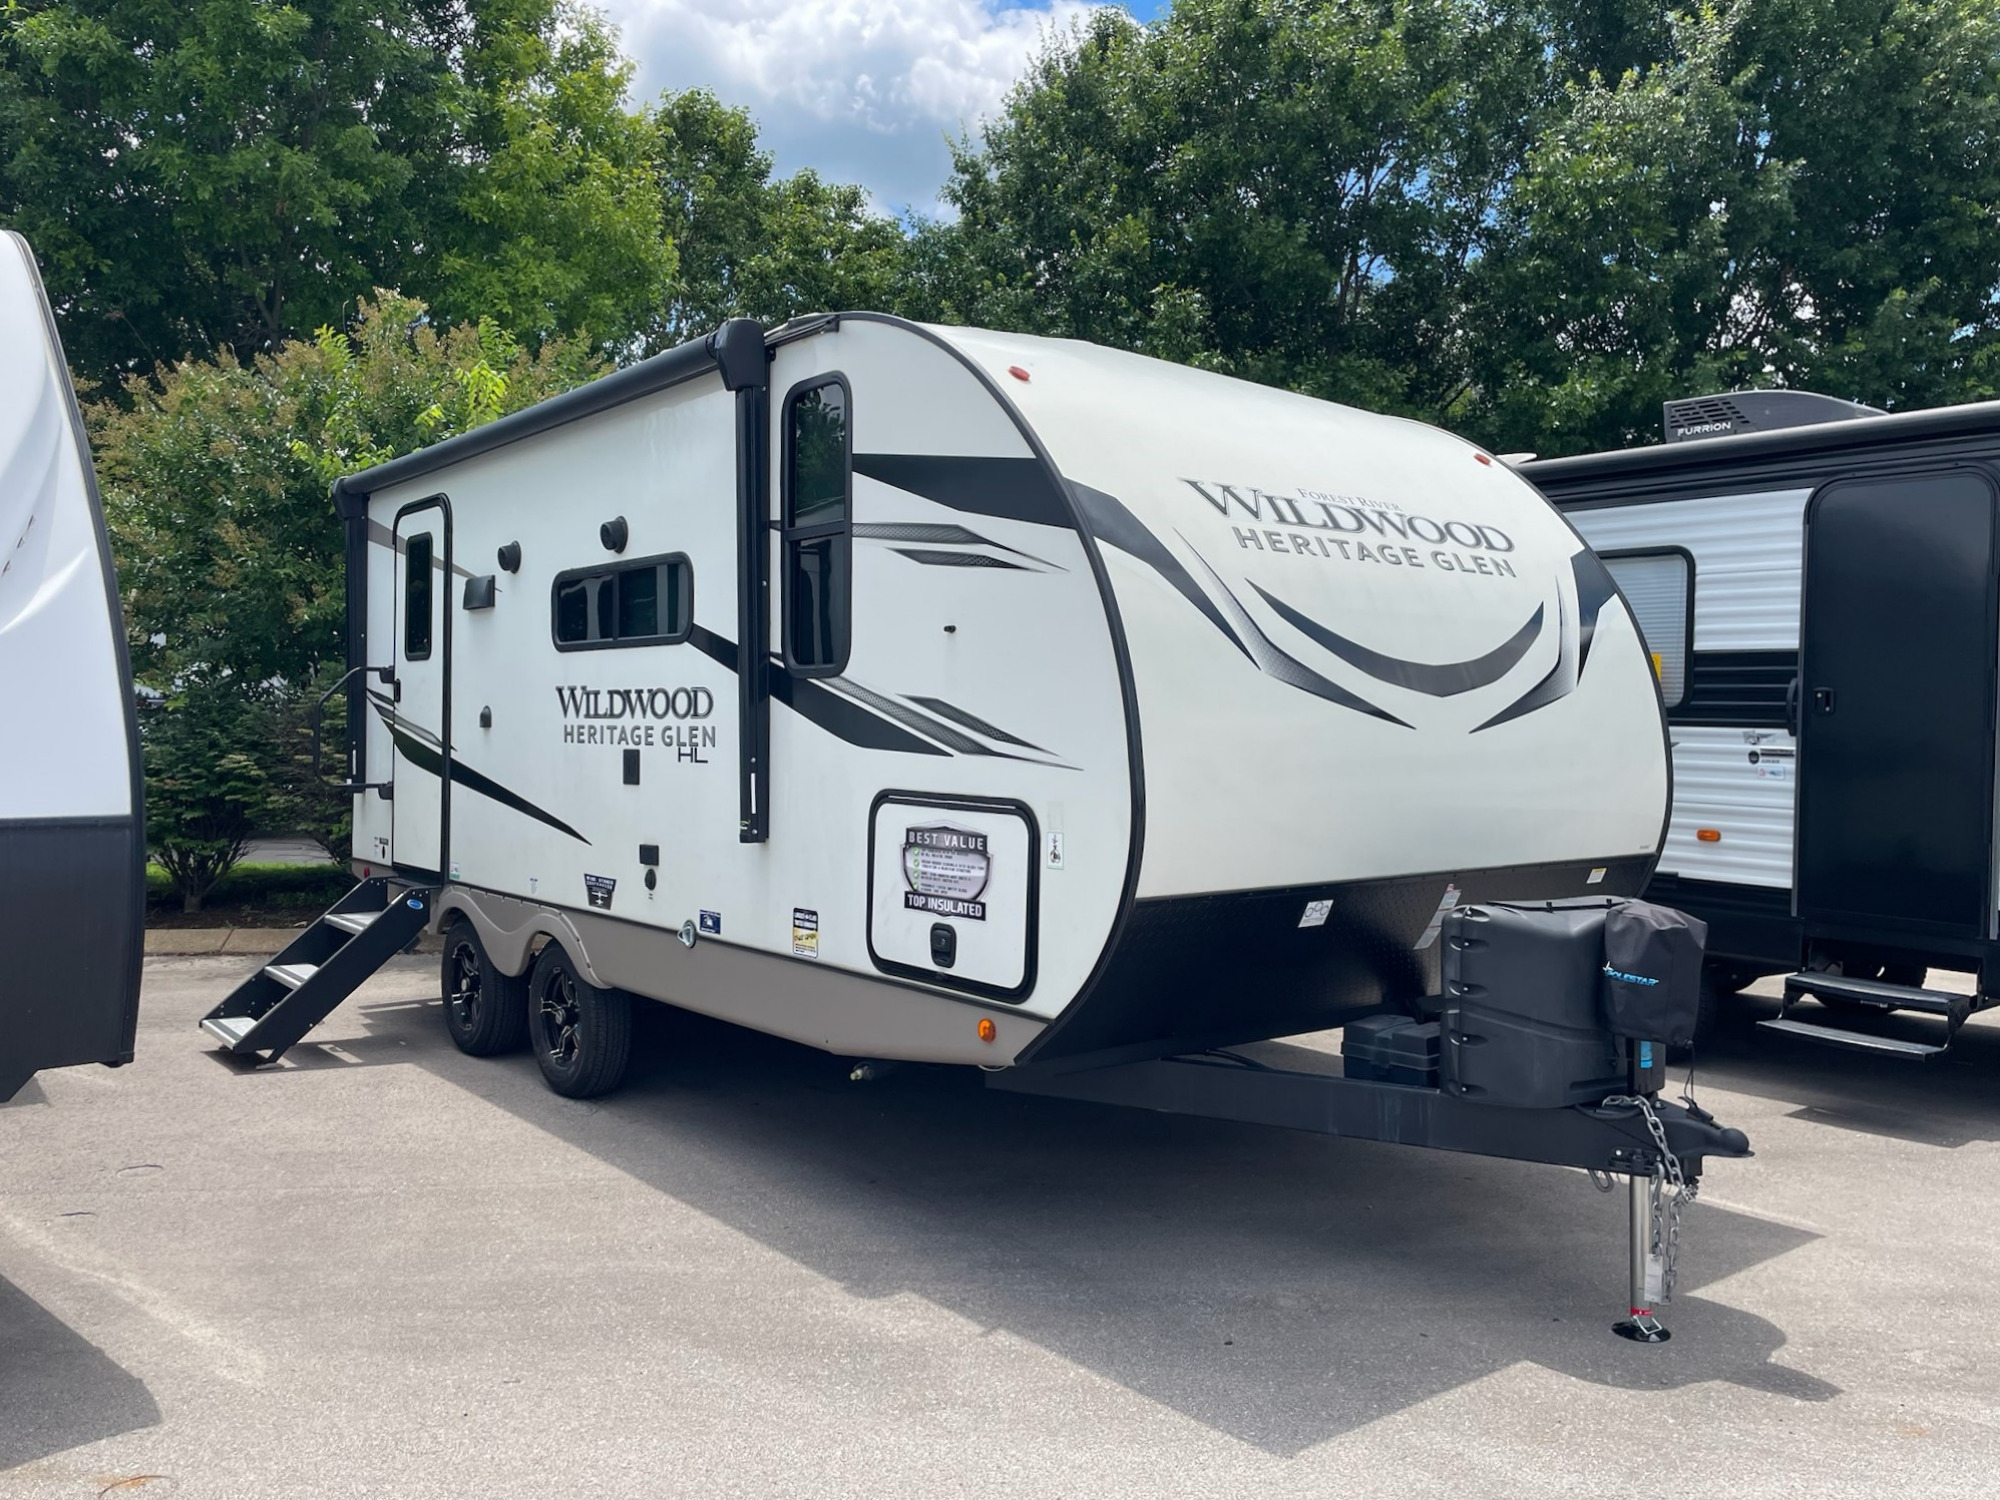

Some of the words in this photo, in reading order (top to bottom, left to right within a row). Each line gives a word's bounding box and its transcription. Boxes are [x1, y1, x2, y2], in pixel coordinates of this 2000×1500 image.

[1677, 422, 1731, 437] FURRION
[1297, 488, 1355, 506] FOREST
[1356, 497, 1403, 511] RIVER
[1178, 477, 1515, 552] WILDWOOD
[1232, 526, 1425, 568] HERITAGE
[1430, 551, 1517, 578] GLEN
[555, 685, 714, 720] WILDWOOD
[564, 724, 655, 746] HERITAGE
[661, 725, 716, 748] GLEN
[677, 747, 709, 763] HL
[908, 831, 938, 845] BEST
[944, 835, 984, 850] VALUE
[907, 894, 926, 908] TOP
[927, 897, 983, 917] INSULATED
